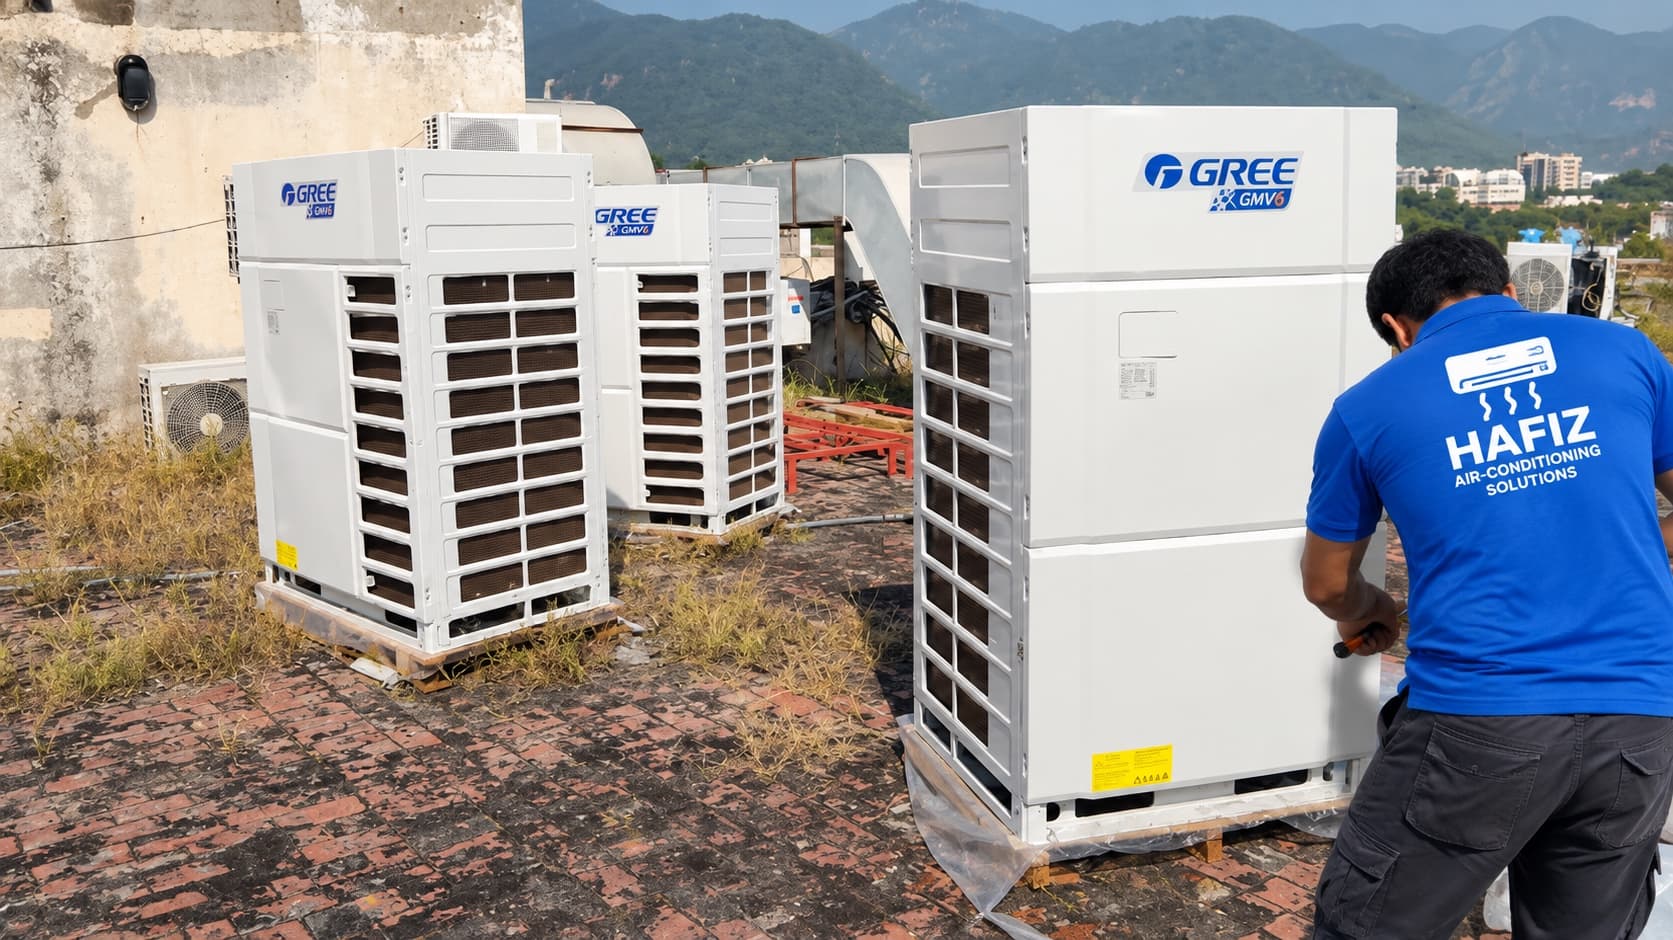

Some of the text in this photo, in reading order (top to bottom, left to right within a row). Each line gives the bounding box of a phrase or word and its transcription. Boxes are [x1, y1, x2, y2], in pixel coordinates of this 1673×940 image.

[1189, 158, 1299, 186] GREE
[297, 182, 337, 203] GREE
[1239, 191, 1285, 207] GMV6
[595, 207, 658, 224] GREE
[621, 225, 649, 234] GMV6
[1445, 405, 1597, 471] HAFIZ
[1455, 444, 1601, 488] AIR-CONDITIONING
[1486, 466, 1578, 496] SOLUTIONS
